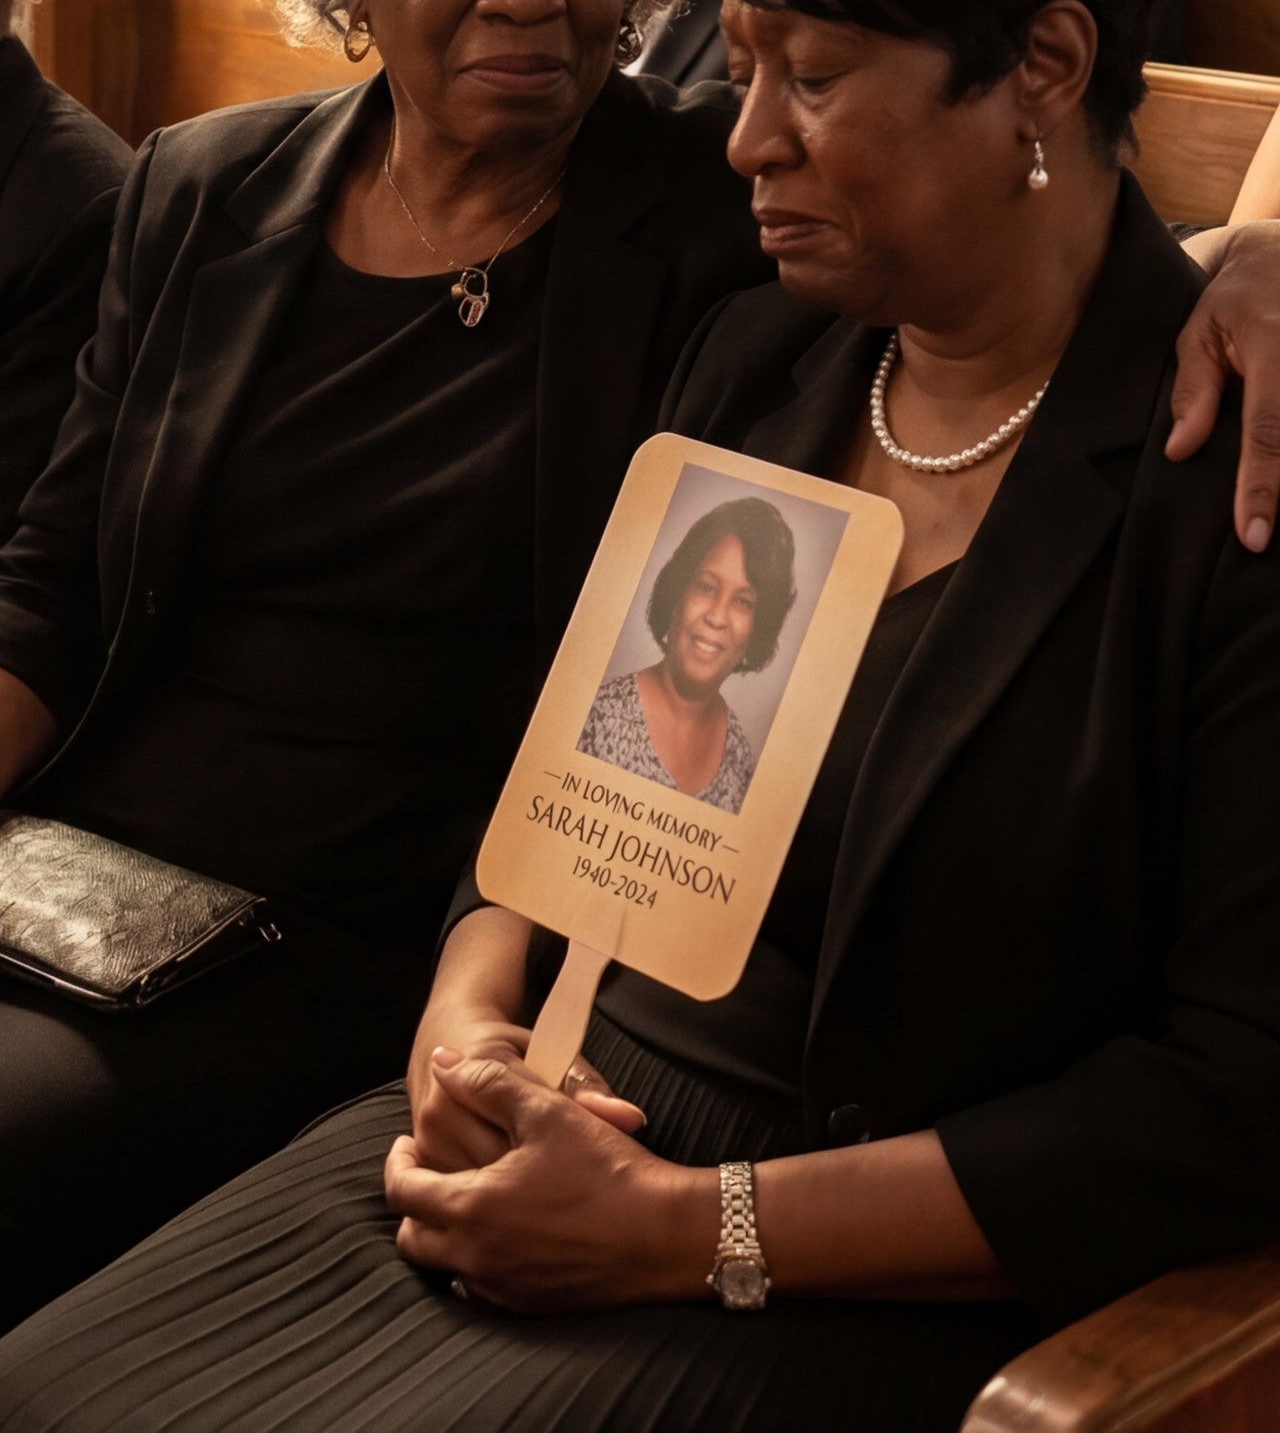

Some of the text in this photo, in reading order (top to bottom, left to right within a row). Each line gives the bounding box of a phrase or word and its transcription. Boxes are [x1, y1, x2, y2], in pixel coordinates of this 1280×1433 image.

[582, 780, 646, 821] LOVING
[526, 795, 737, 905] SARAH JOHNSON
[572, 855, 659, 910] 1940-2024
